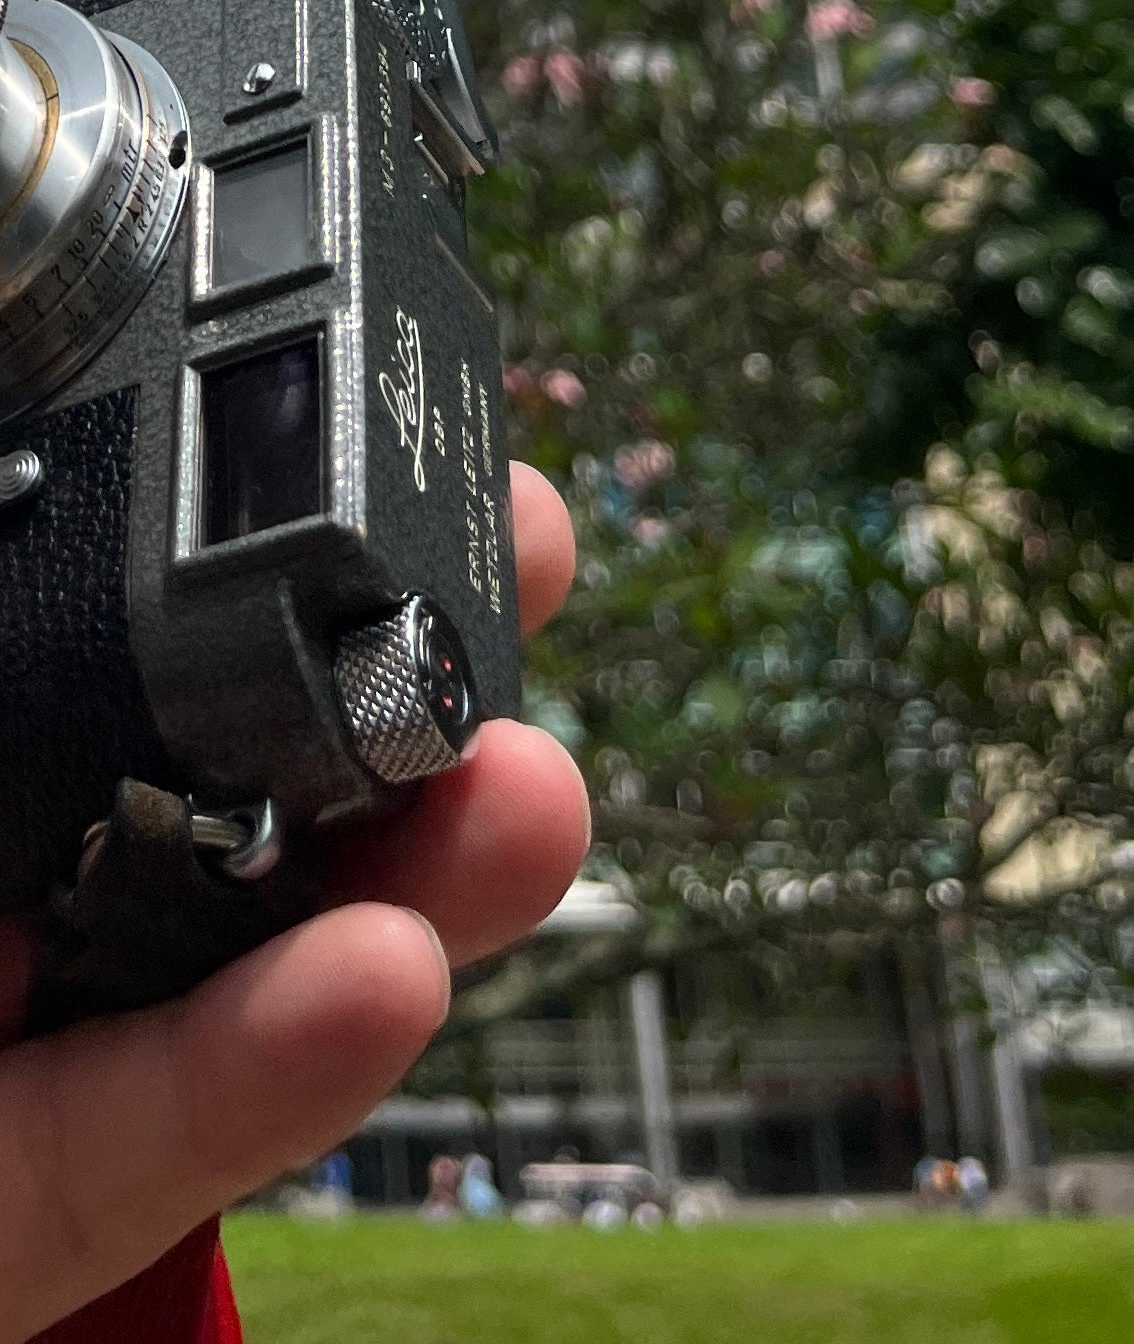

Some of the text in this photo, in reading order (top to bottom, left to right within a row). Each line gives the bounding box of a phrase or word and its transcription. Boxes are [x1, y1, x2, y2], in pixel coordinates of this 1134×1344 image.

[68, 238, 85, 259] 10
[86, 210, 104, 236] 20
[121, 138, 139, 184] mtr
[378, 304, 426, 493] Leica
[433, 405, 446, 457] DBP
[461, 425, 477, 497] LEITZ
[477, 381, 502, 614] WETZLAR GERMANY
[466, 500, 482, 593] ERNST
